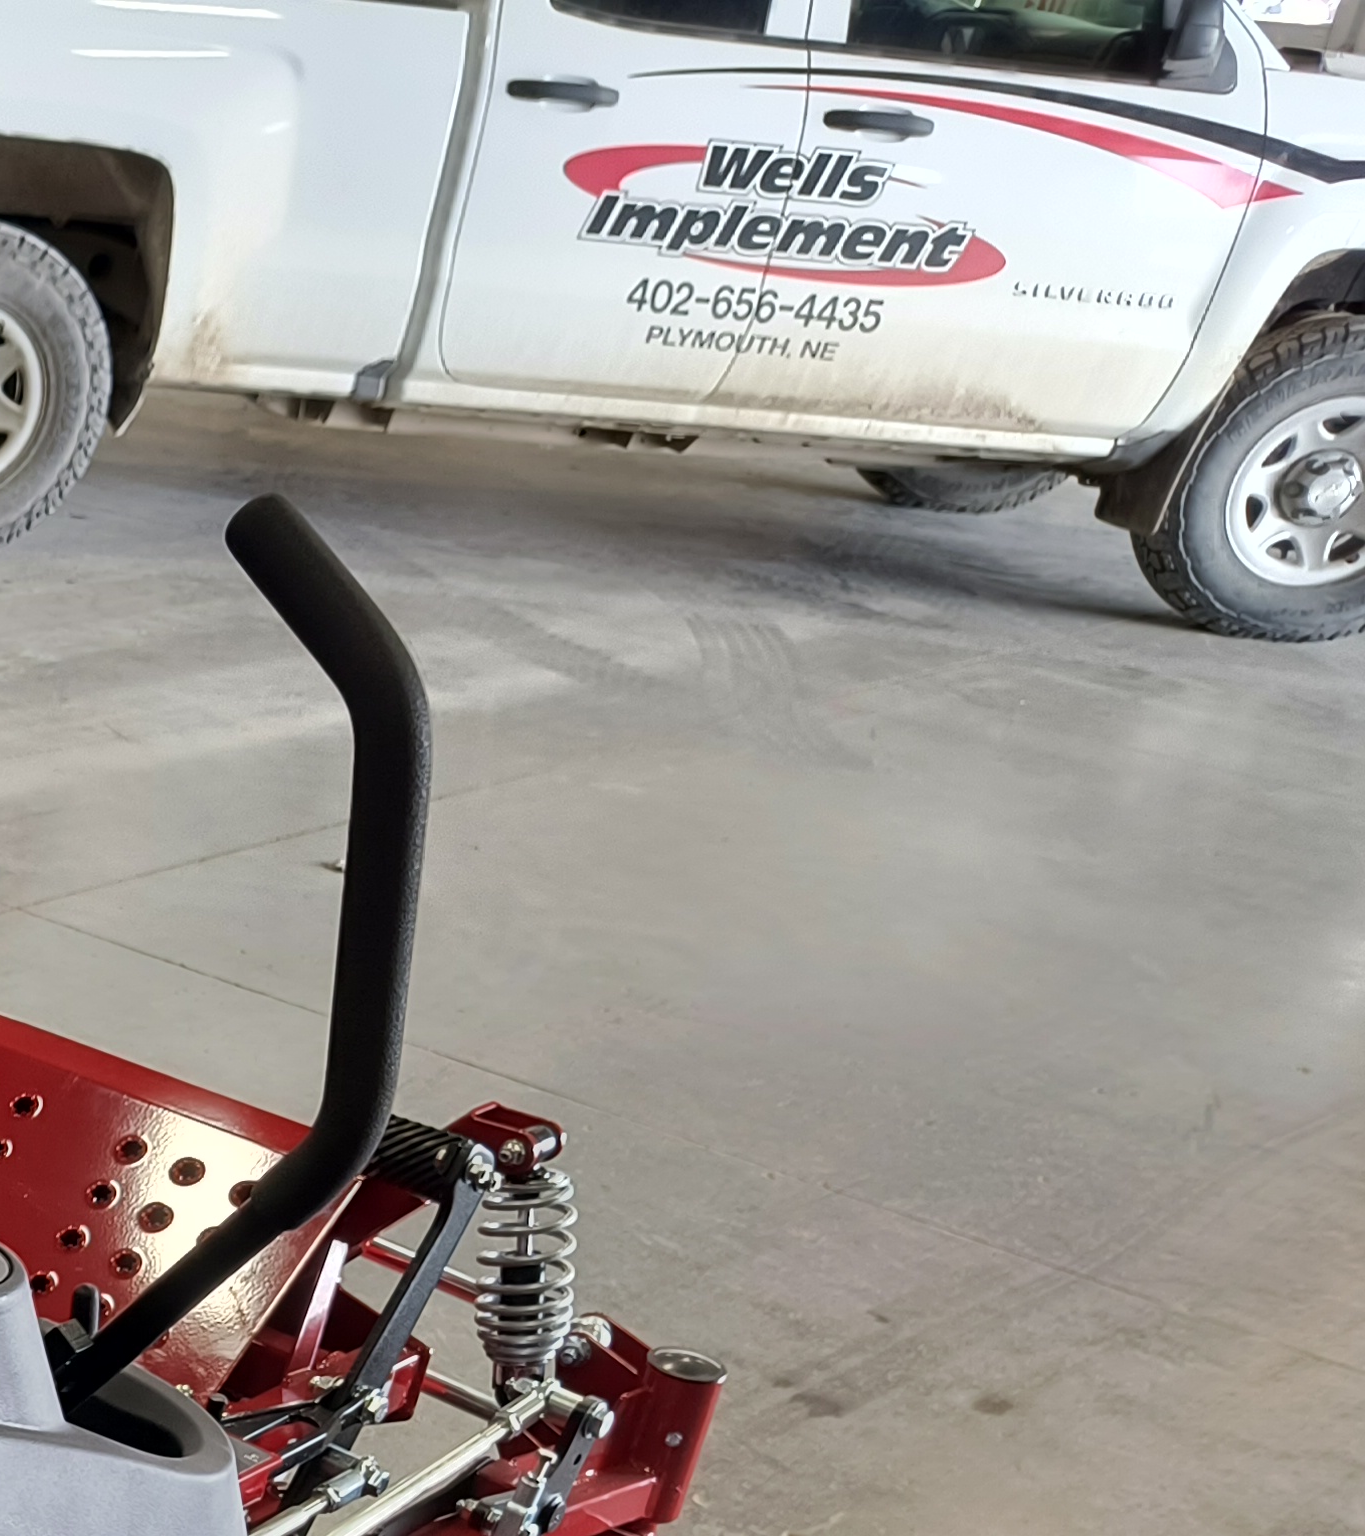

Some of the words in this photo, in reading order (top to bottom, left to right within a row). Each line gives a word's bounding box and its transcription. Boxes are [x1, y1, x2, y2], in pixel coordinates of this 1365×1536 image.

[701, 143, 890, 203] Wells
[585, 194, 964, 268] Implement
[626, 277, 885, 333] 402-656-4435
[799, 340, 841, 362] NE
